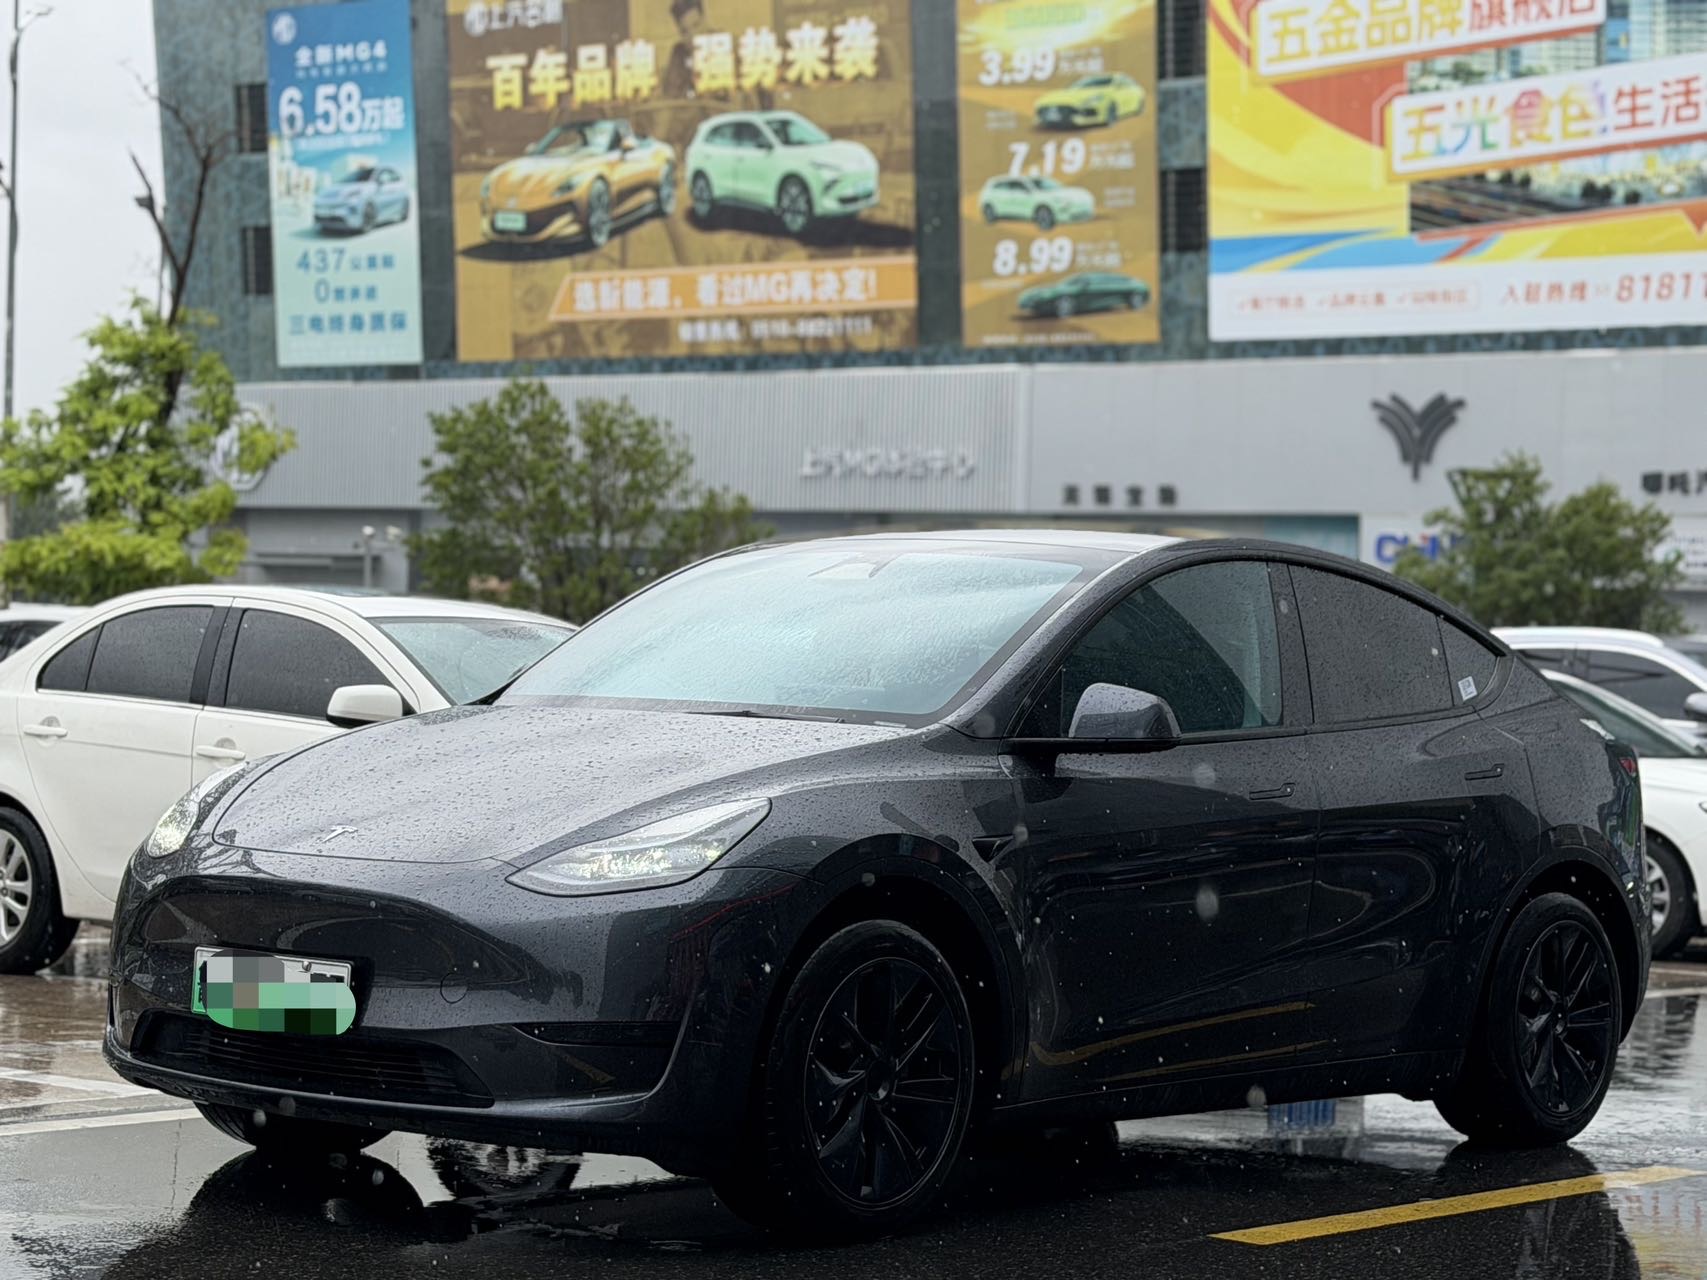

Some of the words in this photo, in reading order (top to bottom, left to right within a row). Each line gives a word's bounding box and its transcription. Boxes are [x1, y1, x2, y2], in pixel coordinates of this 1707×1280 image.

[487, 41, 658, 109] 百年品牌
[692, 16, 879, 93] 强势来袭
[978, 48, 1056, 85] 3.99
[1009, 138, 1086, 177] 7.19
[993, 236, 1073, 276] 8.99
